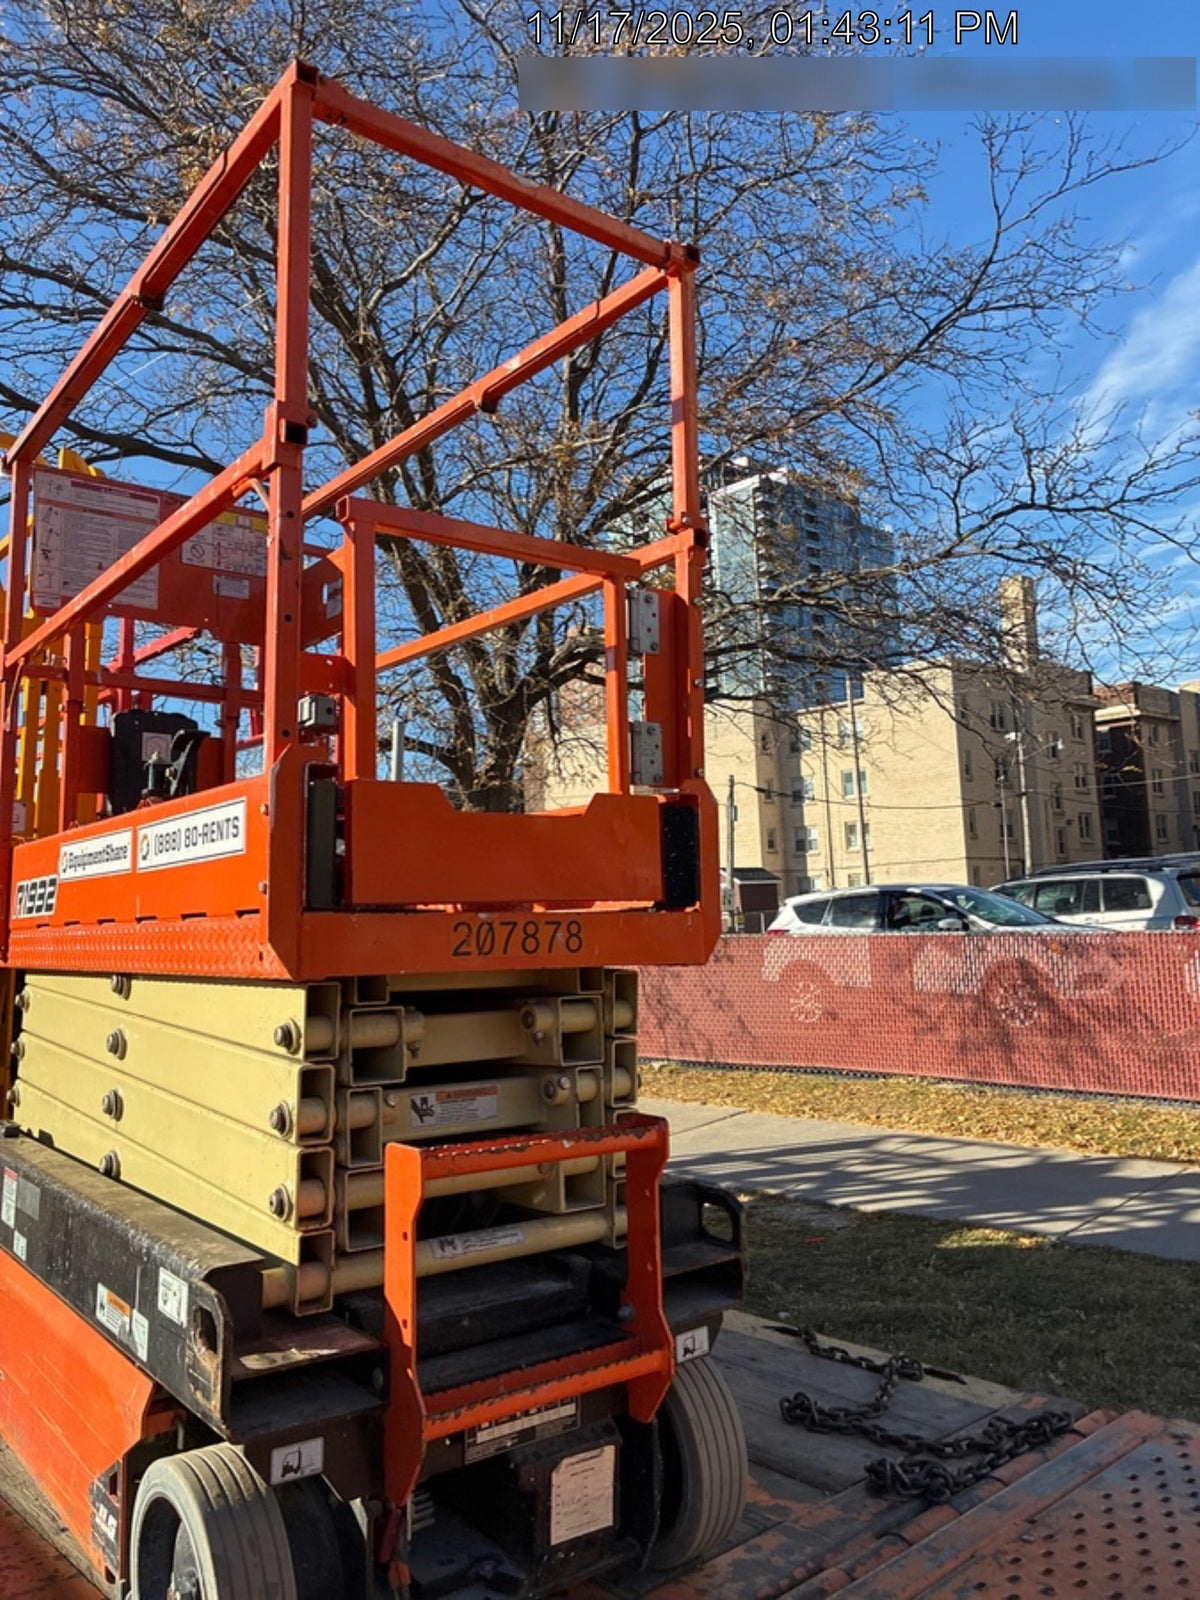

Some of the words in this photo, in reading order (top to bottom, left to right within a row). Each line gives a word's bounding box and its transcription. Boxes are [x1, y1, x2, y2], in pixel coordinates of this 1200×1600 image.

[154, 828, 181, 856] (888)
[184, 815, 240, 848] 80-RENTS
[68, 843, 128, 872] EquipmentShare
[451, 920, 583, 957] 207878
